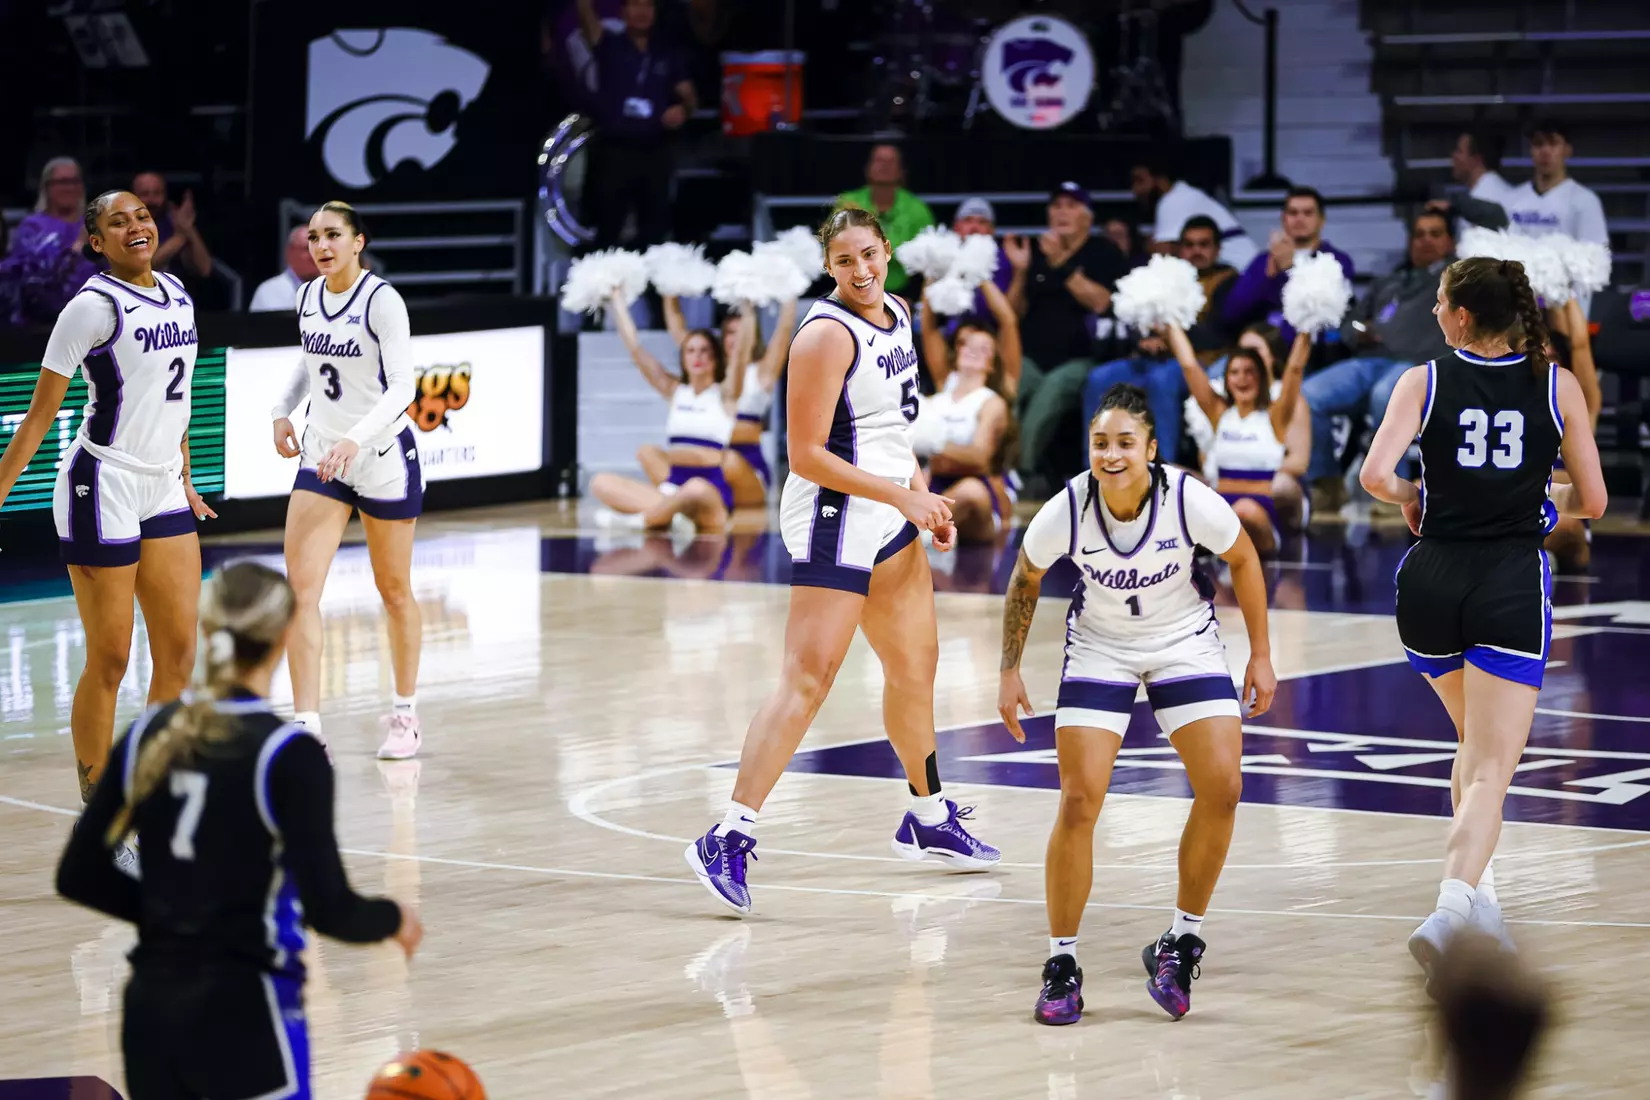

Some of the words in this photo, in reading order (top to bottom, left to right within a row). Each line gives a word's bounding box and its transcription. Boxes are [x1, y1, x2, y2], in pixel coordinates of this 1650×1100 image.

[301, 330, 363, 357] Wildcats
[165, 356, 185, 403] 2
[319, 363, 343, 401] 3
[1456, 407, 1524, 469] 33
[1083, 562, 1180, 590] Wildcats
[1125, 594, 1142, 616] 1
[168, 770, 208, 861] 7
